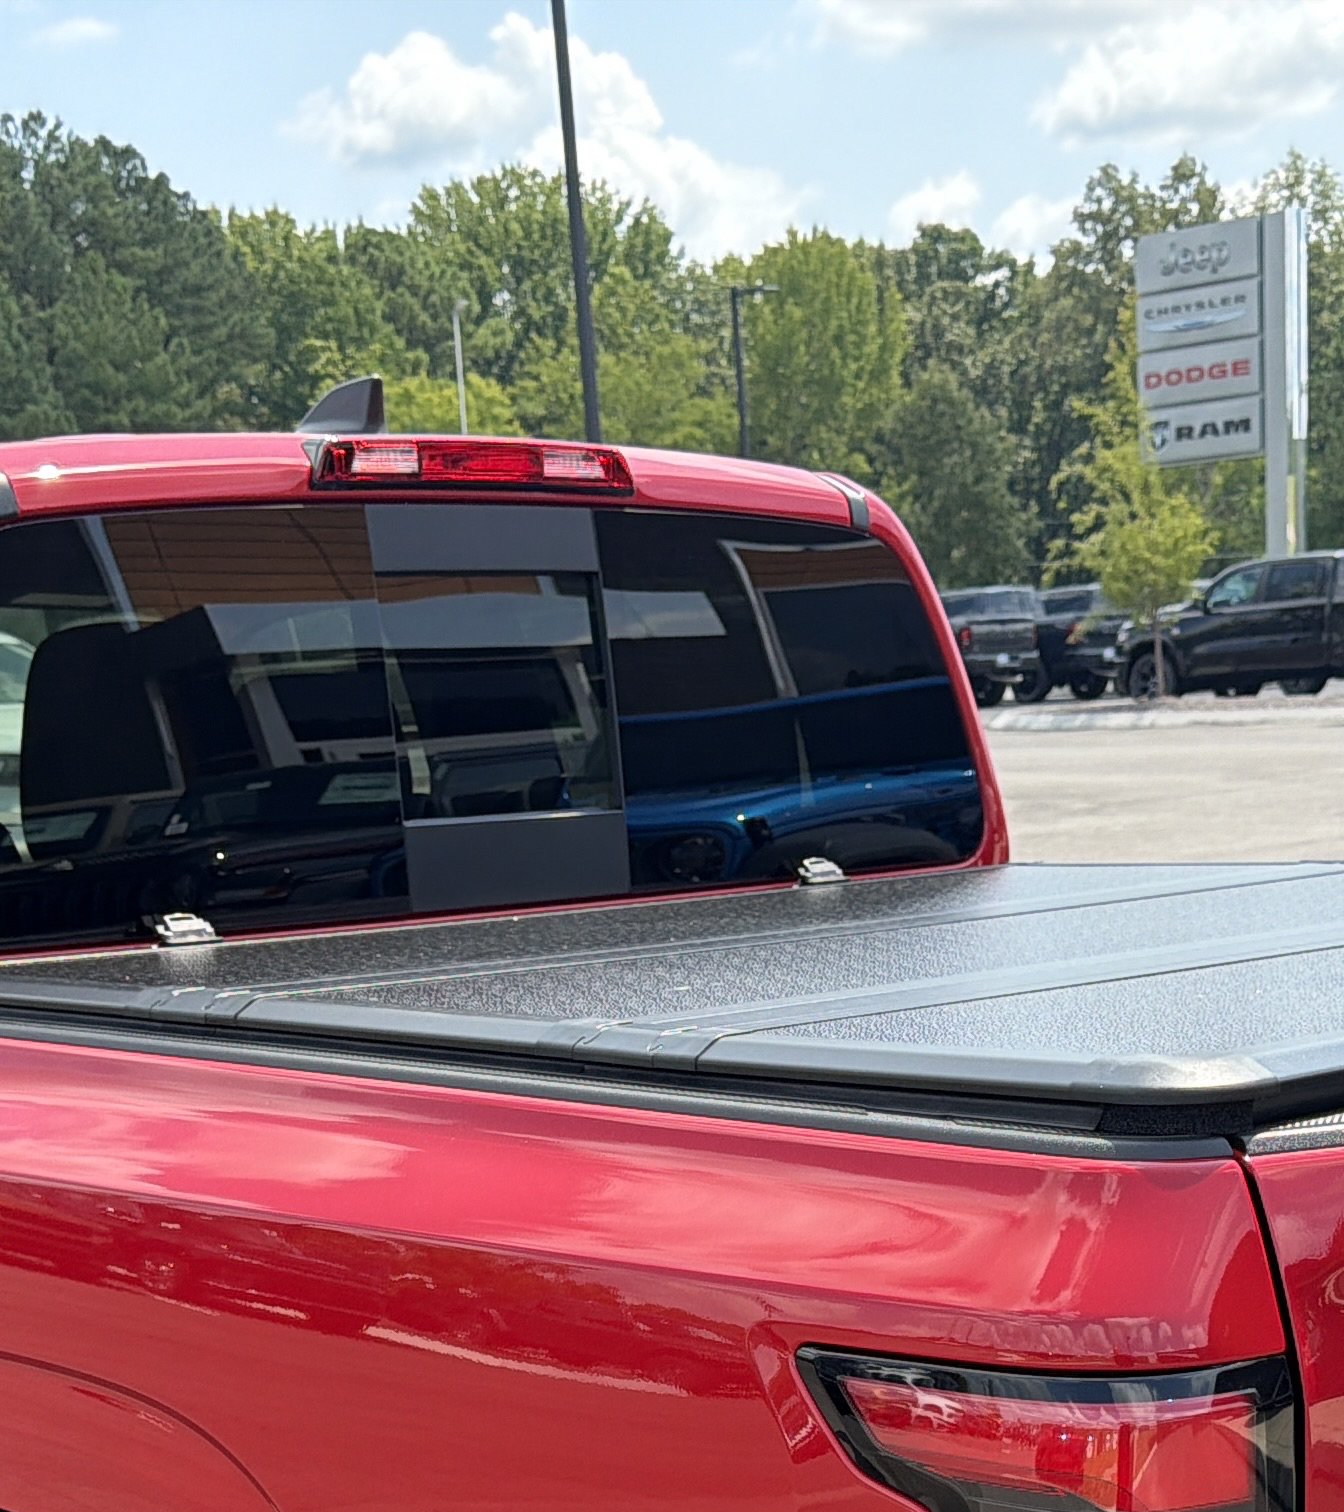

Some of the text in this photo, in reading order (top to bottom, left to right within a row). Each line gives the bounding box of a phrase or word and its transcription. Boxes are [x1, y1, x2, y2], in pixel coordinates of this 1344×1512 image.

[1159, 240, 1231, 276] Jeep
[1143, 294, 1248, 320] CHRYSLER
[1143, 358, 1251, 390] DODGE
[1175, 417, 1251, 442] RAM
